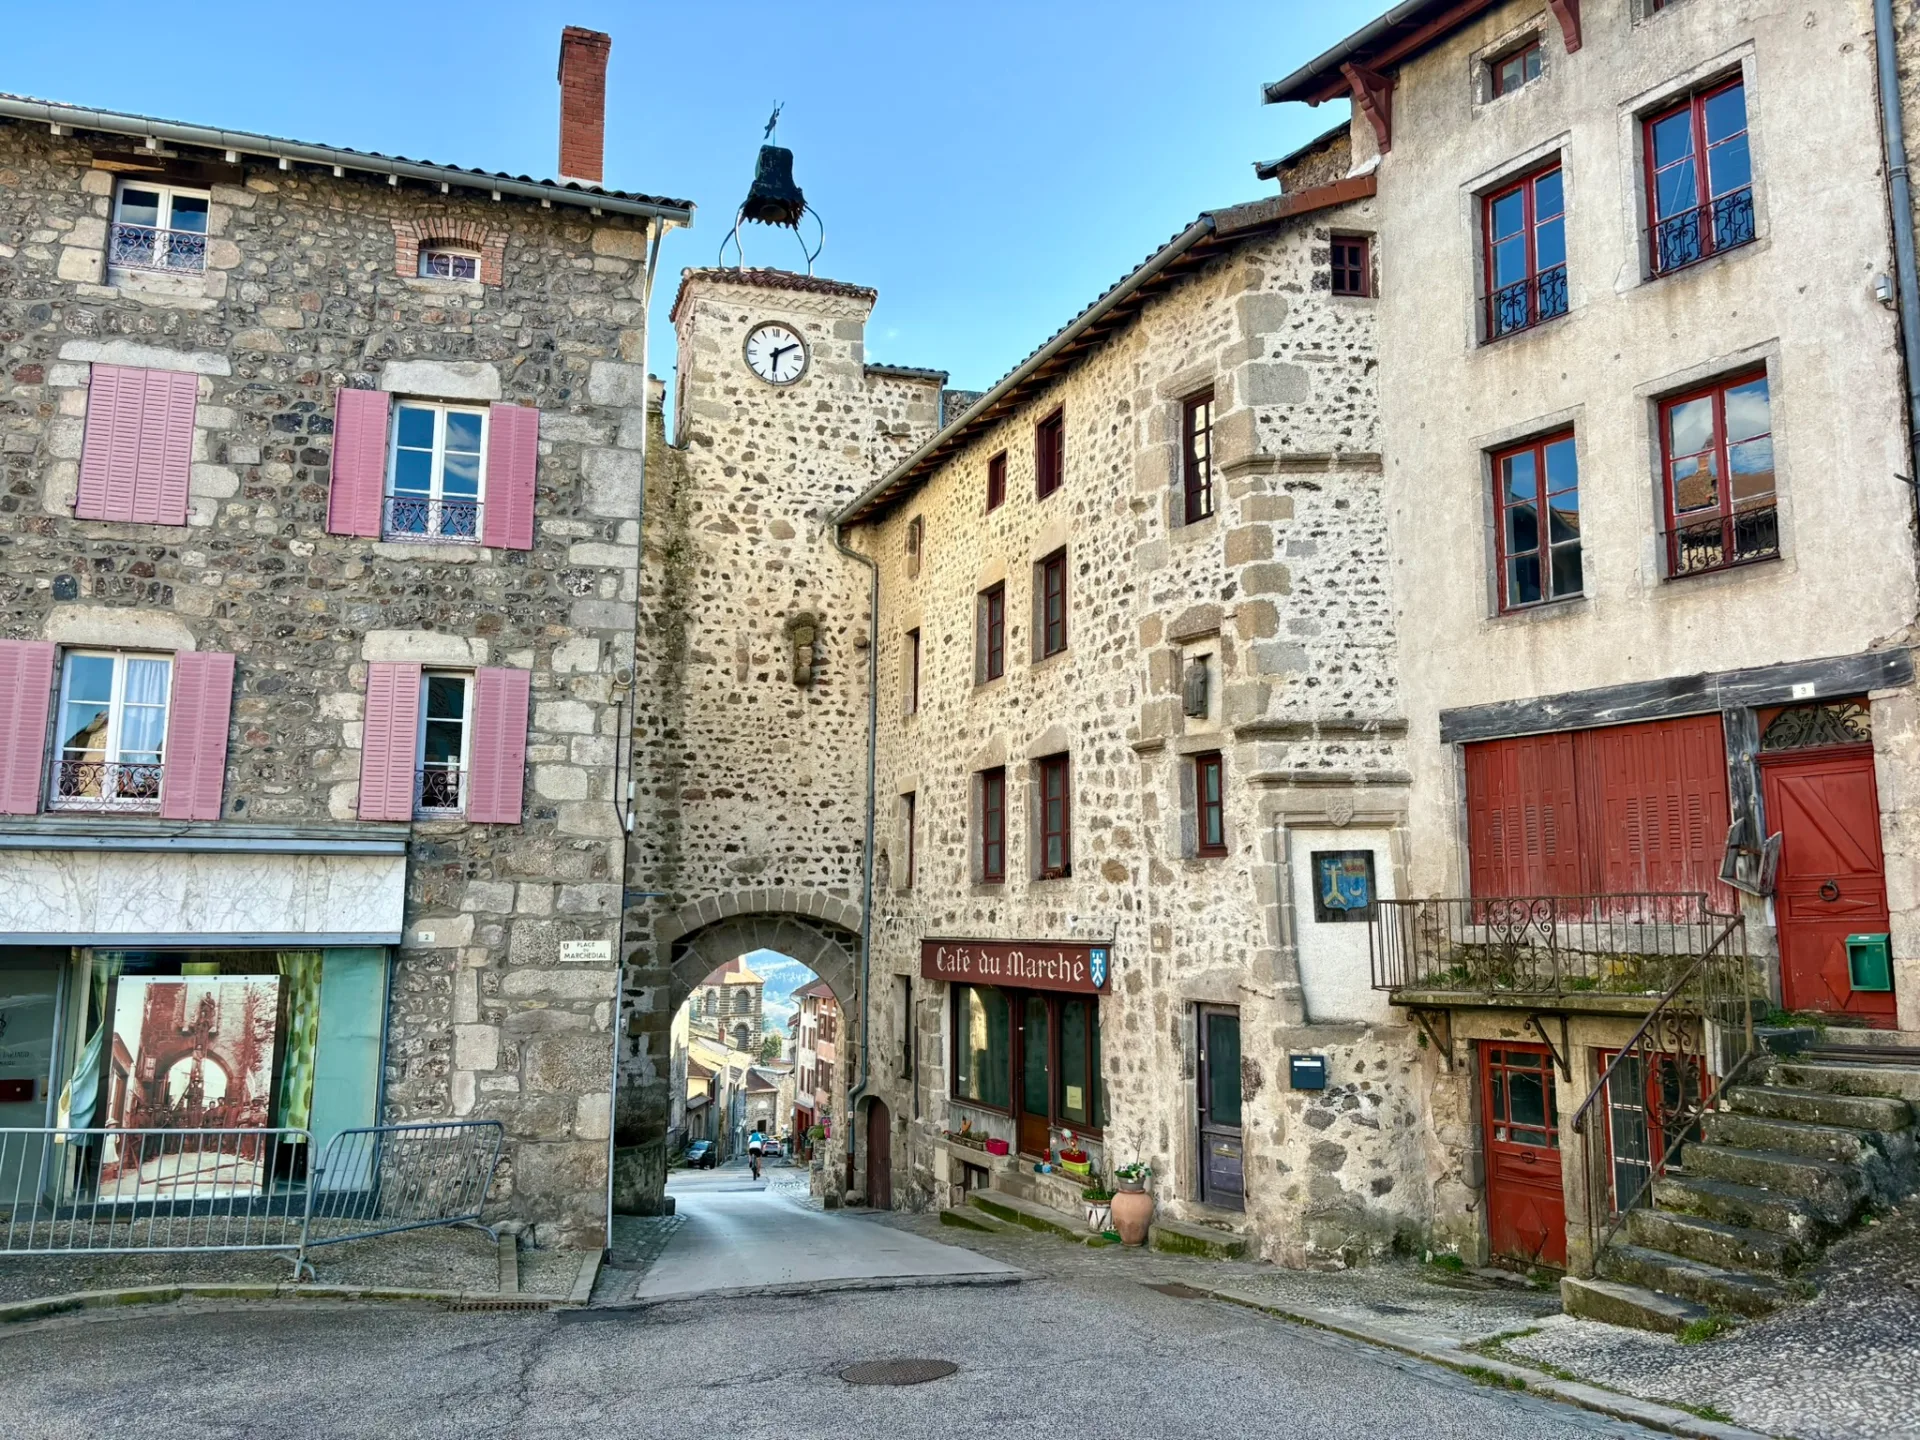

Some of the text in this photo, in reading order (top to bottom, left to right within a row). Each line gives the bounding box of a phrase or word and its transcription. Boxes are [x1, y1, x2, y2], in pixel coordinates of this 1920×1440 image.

[1800, 686, 1806, 694] 3
[936, 946, 1084, 982] Café du Marché
